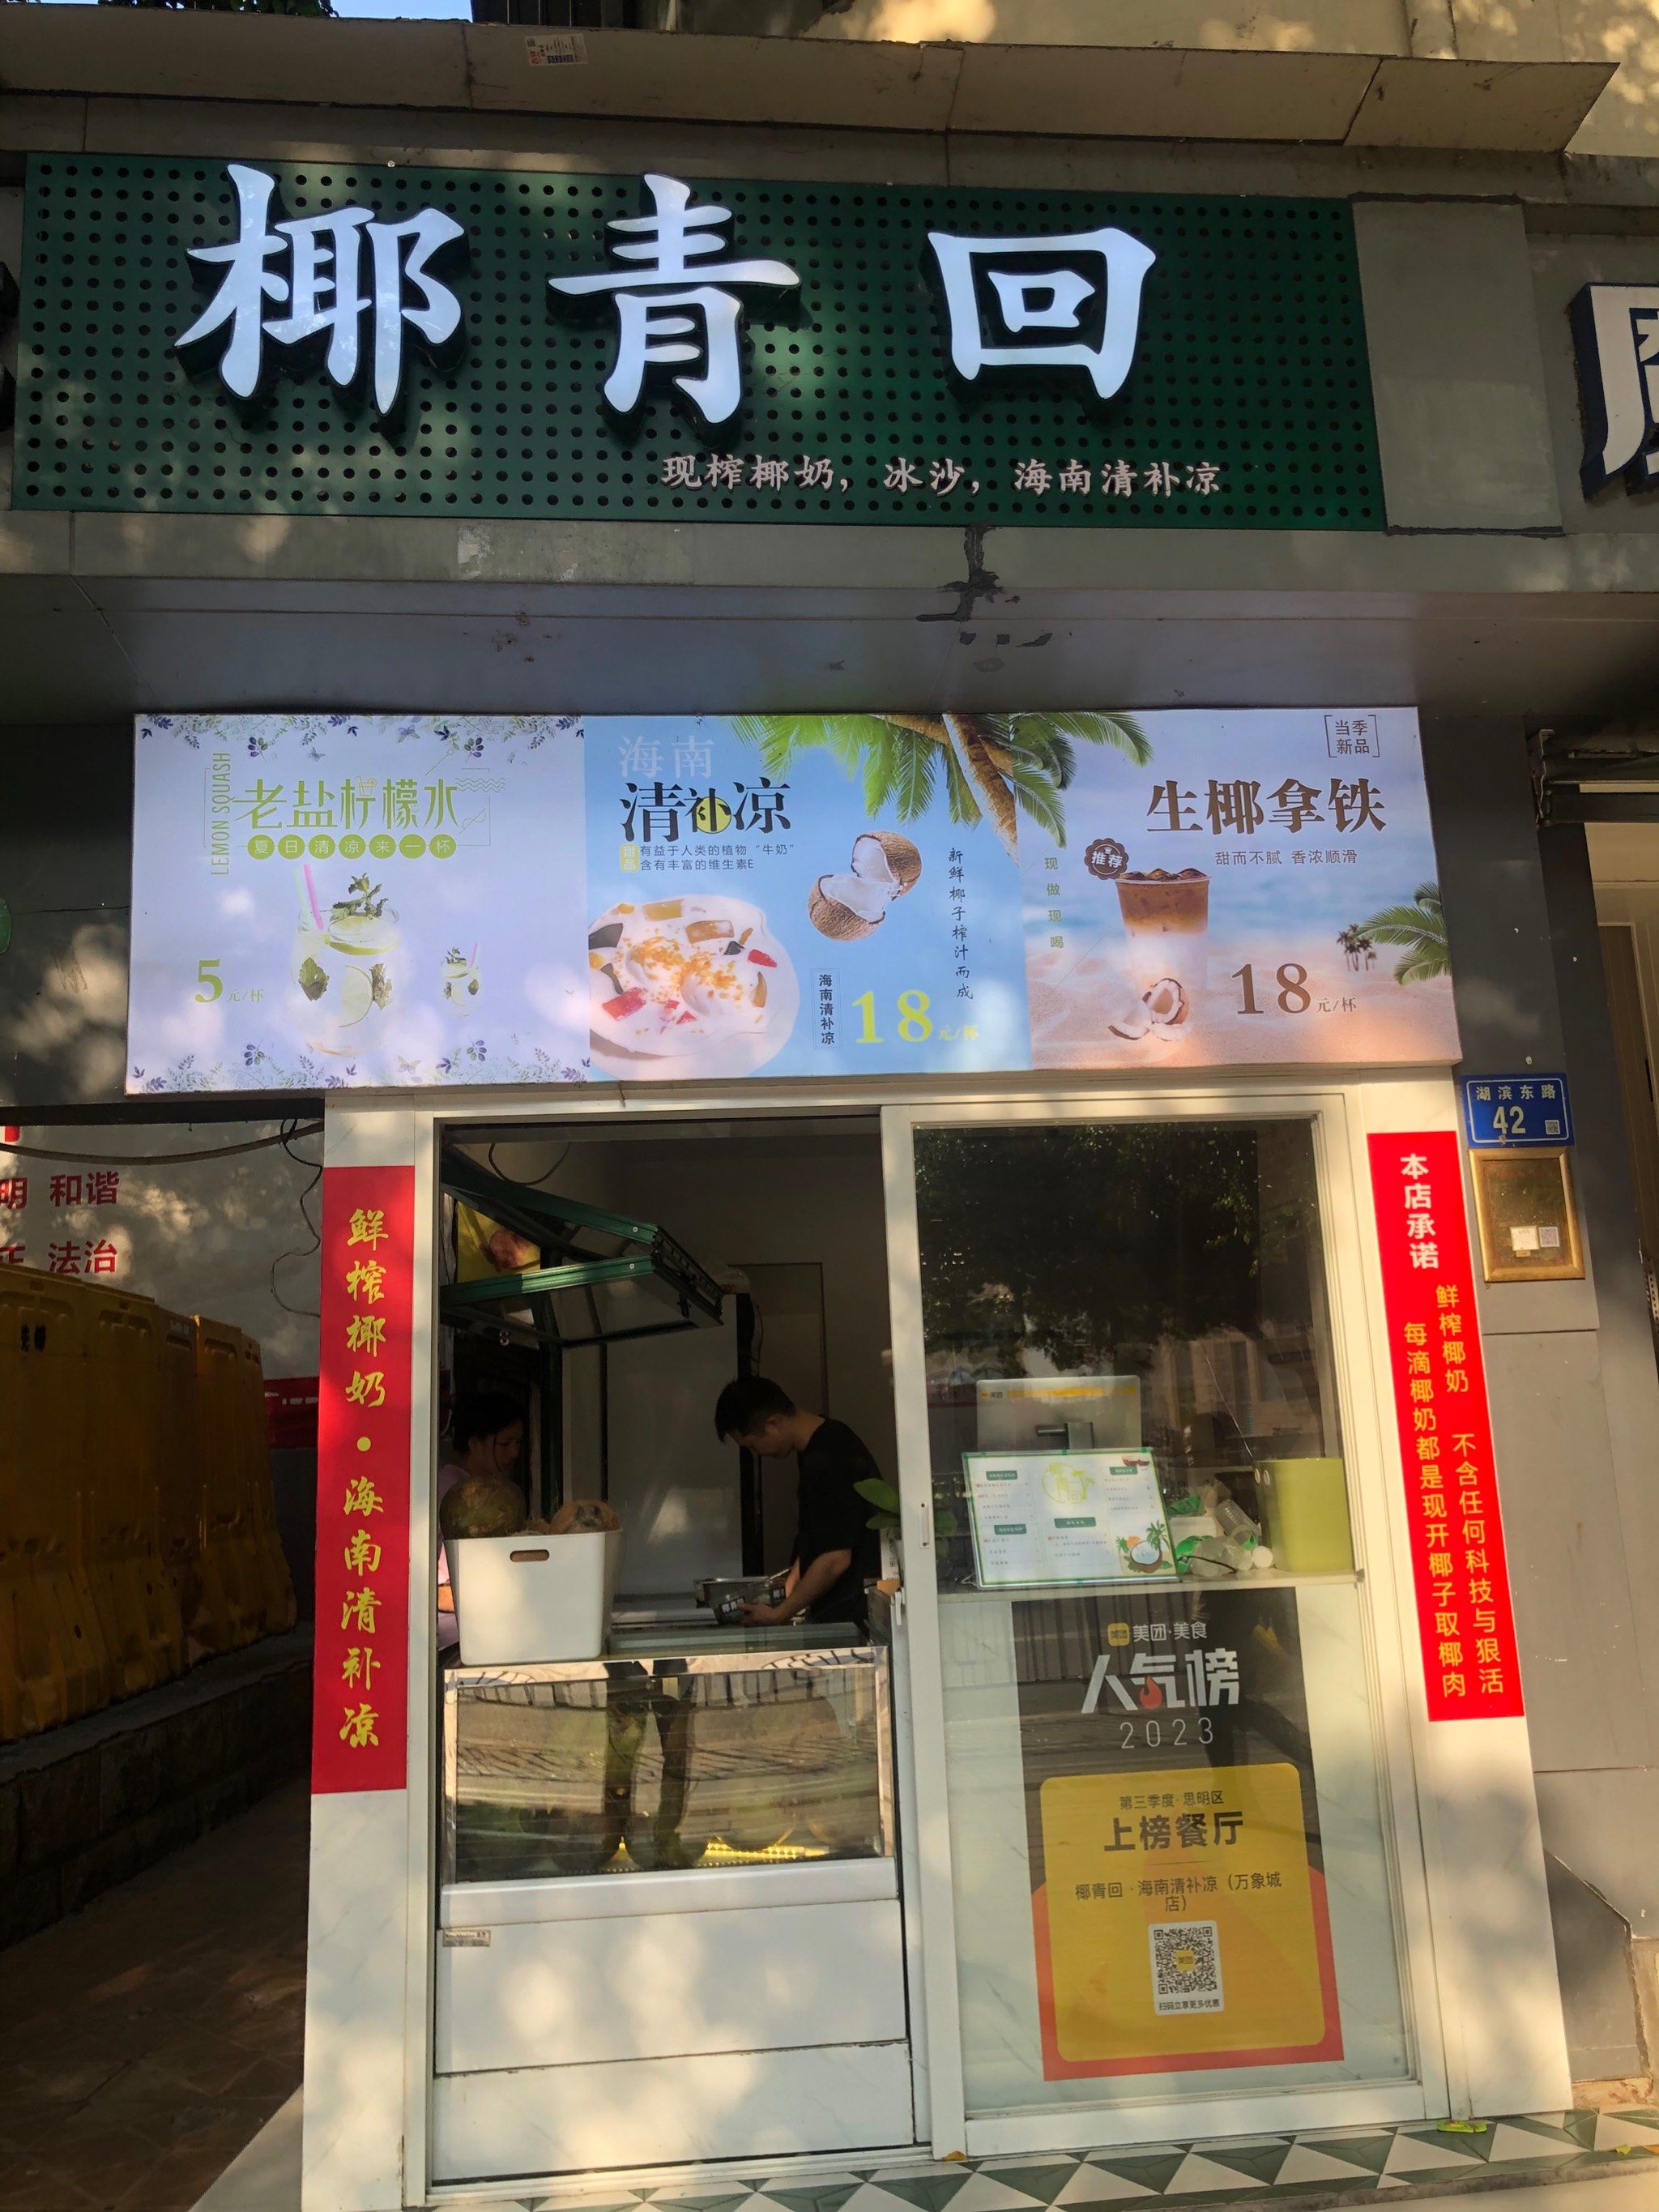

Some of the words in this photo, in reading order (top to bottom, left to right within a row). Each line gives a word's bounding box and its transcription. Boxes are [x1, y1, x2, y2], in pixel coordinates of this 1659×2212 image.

[174, 164, 1157, 424] 椰青回
[1334, 719, 1369, 737] 当季
[1336, 738, 1371, 755] 新品
[211, 752, 231, 814] SQUASH
[617, 735, 714, 780] 海南
[233, 778, 459, 831] 老盐柠檬水
[619, 777, 791, 843] 清补凉
[1146, 778, 1387, 835] 生椰拿铁
[211, 819, 230, 876] LEMON
[252, 839, 452, 855] 夏日清凉来一杯
[640, 858, 754, 872] 含有丰富的维生素E
[1091, 851, 1123, 869] 推荐
[1214, 849, 1282, 866] 甜而不腻
[1291, 848, 1358, 865] 香浓顺滑
[947, 847, 975, 1001] 新鲜椰子榨汁而成
[1044, 856, 1064, 950] 现做现喝
[194, 959, 222, 1003] 5
[1231, 963, 1311, 1015] 18
[1316, 997, 1357, 1014] 元/杯
[818, 973, 836, 1045] 海南清补凉
[852, 989, 933, 1044] 18
[1476, 1084, 1556, 1101] 湖滨东路
[1493, 1105, 1526, 1134] 42
[49, 1171, 120, 1207] 和谐
[1400, 1153, 1439, 1270] 本店承诺
[48, 1239, 117, 1275] 法治
[1404, 1322, 1466, 1698] 每滴椰奶都是现开椰子取椰肉
[1435, 1284, 1469, 1393] 鲜榨椰奶
[1452, 1433, 1504, 1695] 不含任何科技与狠活
[1081, 1648, 1239, 1714] 人气榜
[1120, 1717, 1214, 1749] 2023
[1103, 1811, 1243, 1852] 上榜餐厅
